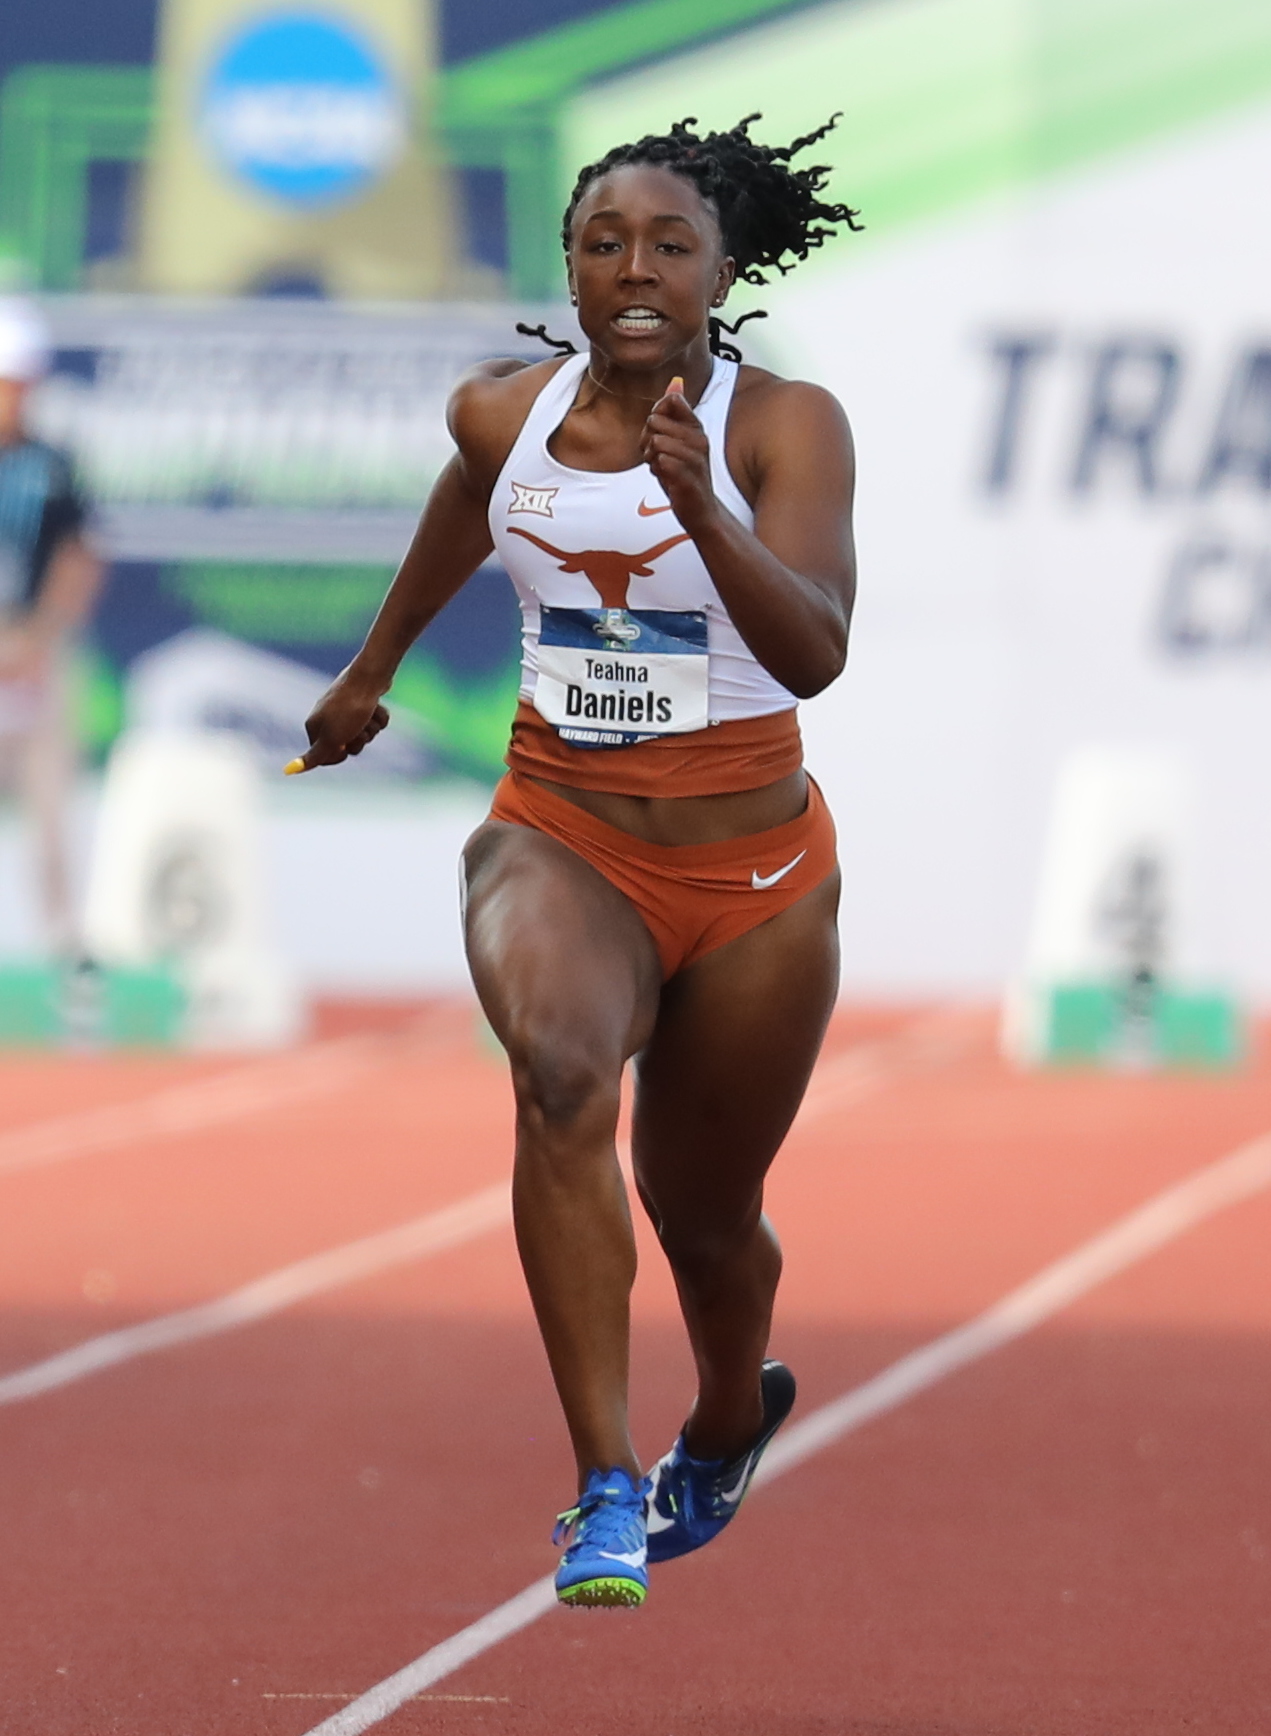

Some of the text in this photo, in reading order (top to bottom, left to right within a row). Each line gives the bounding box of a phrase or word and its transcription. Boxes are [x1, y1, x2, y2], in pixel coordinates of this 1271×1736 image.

[585, 658, 648, 683] Teahna
[565, 684, 672, 723] Daniels
[559, 727, 600, 742] HAYWARD
[600, 732, 623, 744] FIELD
